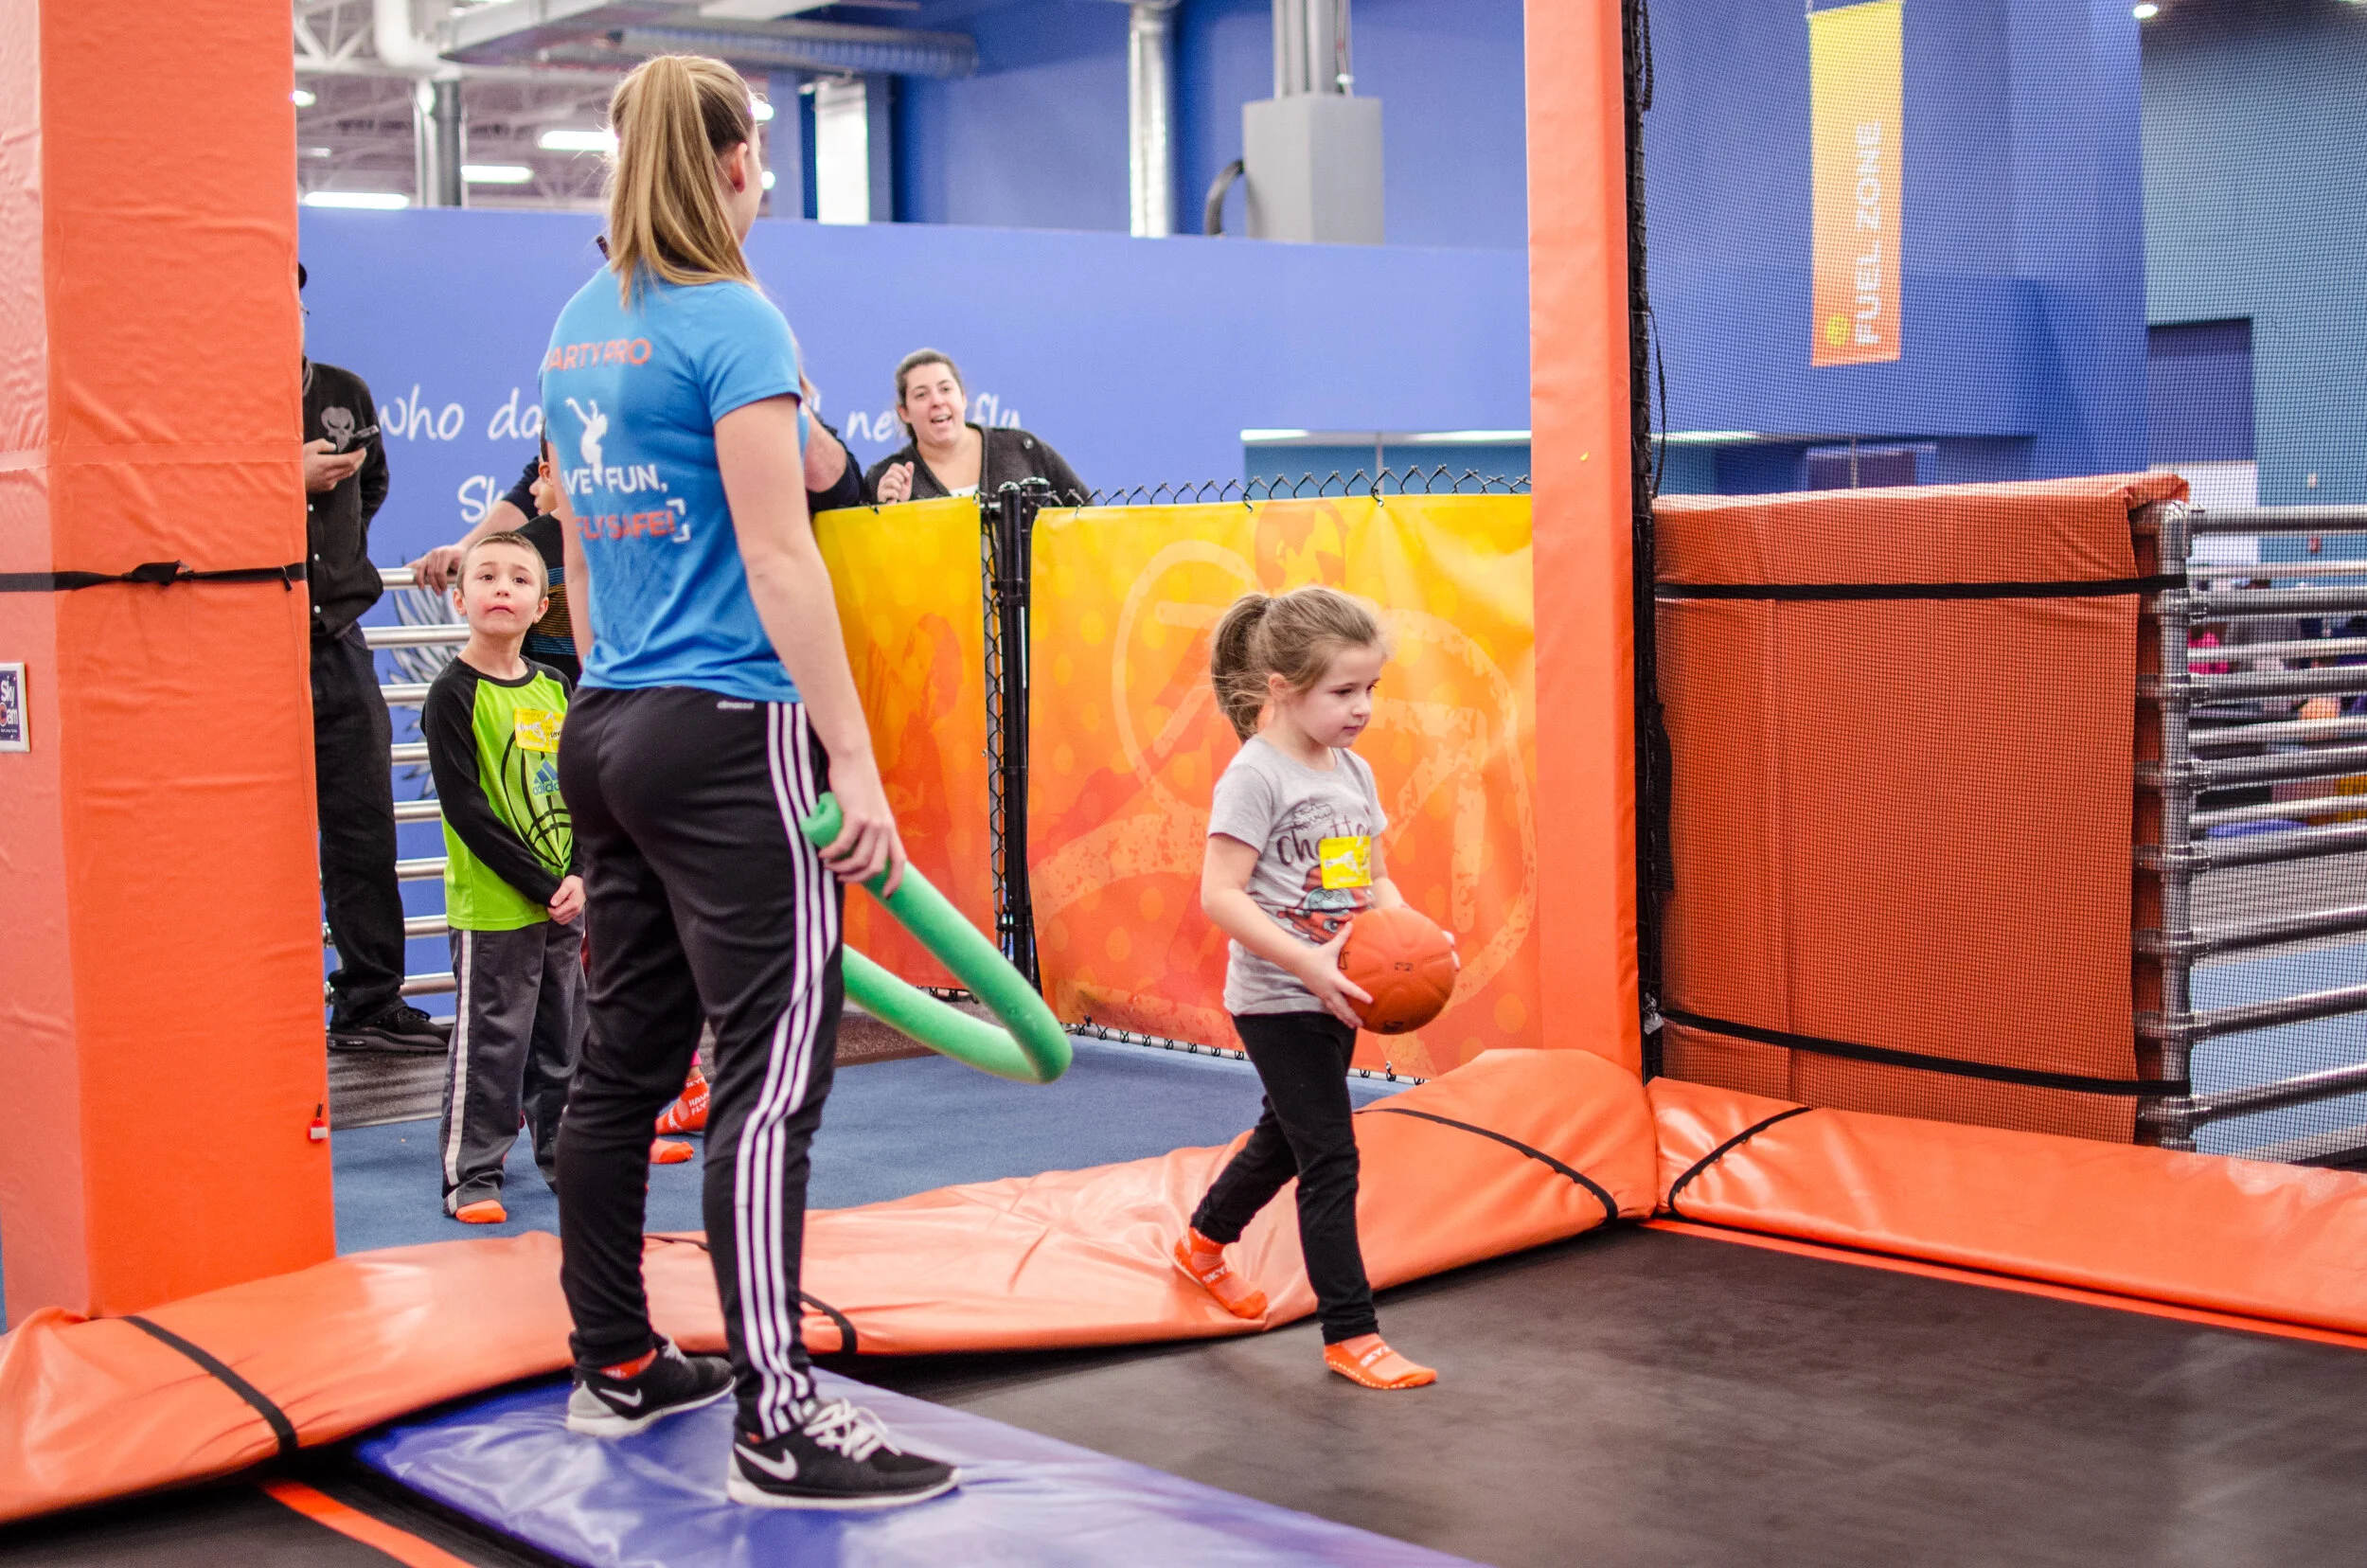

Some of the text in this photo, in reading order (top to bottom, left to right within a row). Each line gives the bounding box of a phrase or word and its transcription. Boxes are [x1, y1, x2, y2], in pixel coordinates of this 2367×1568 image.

[1855, 120, 1881, 346] FUEL ZONE
[546, 338, 652, 372] ARTY PRO
[379, 383, 464, 441] who
[457, 474, 504, 523] Sk
[604, 464, 668, 493] FUN,
[608, 510, 676, 540] SAFE!
